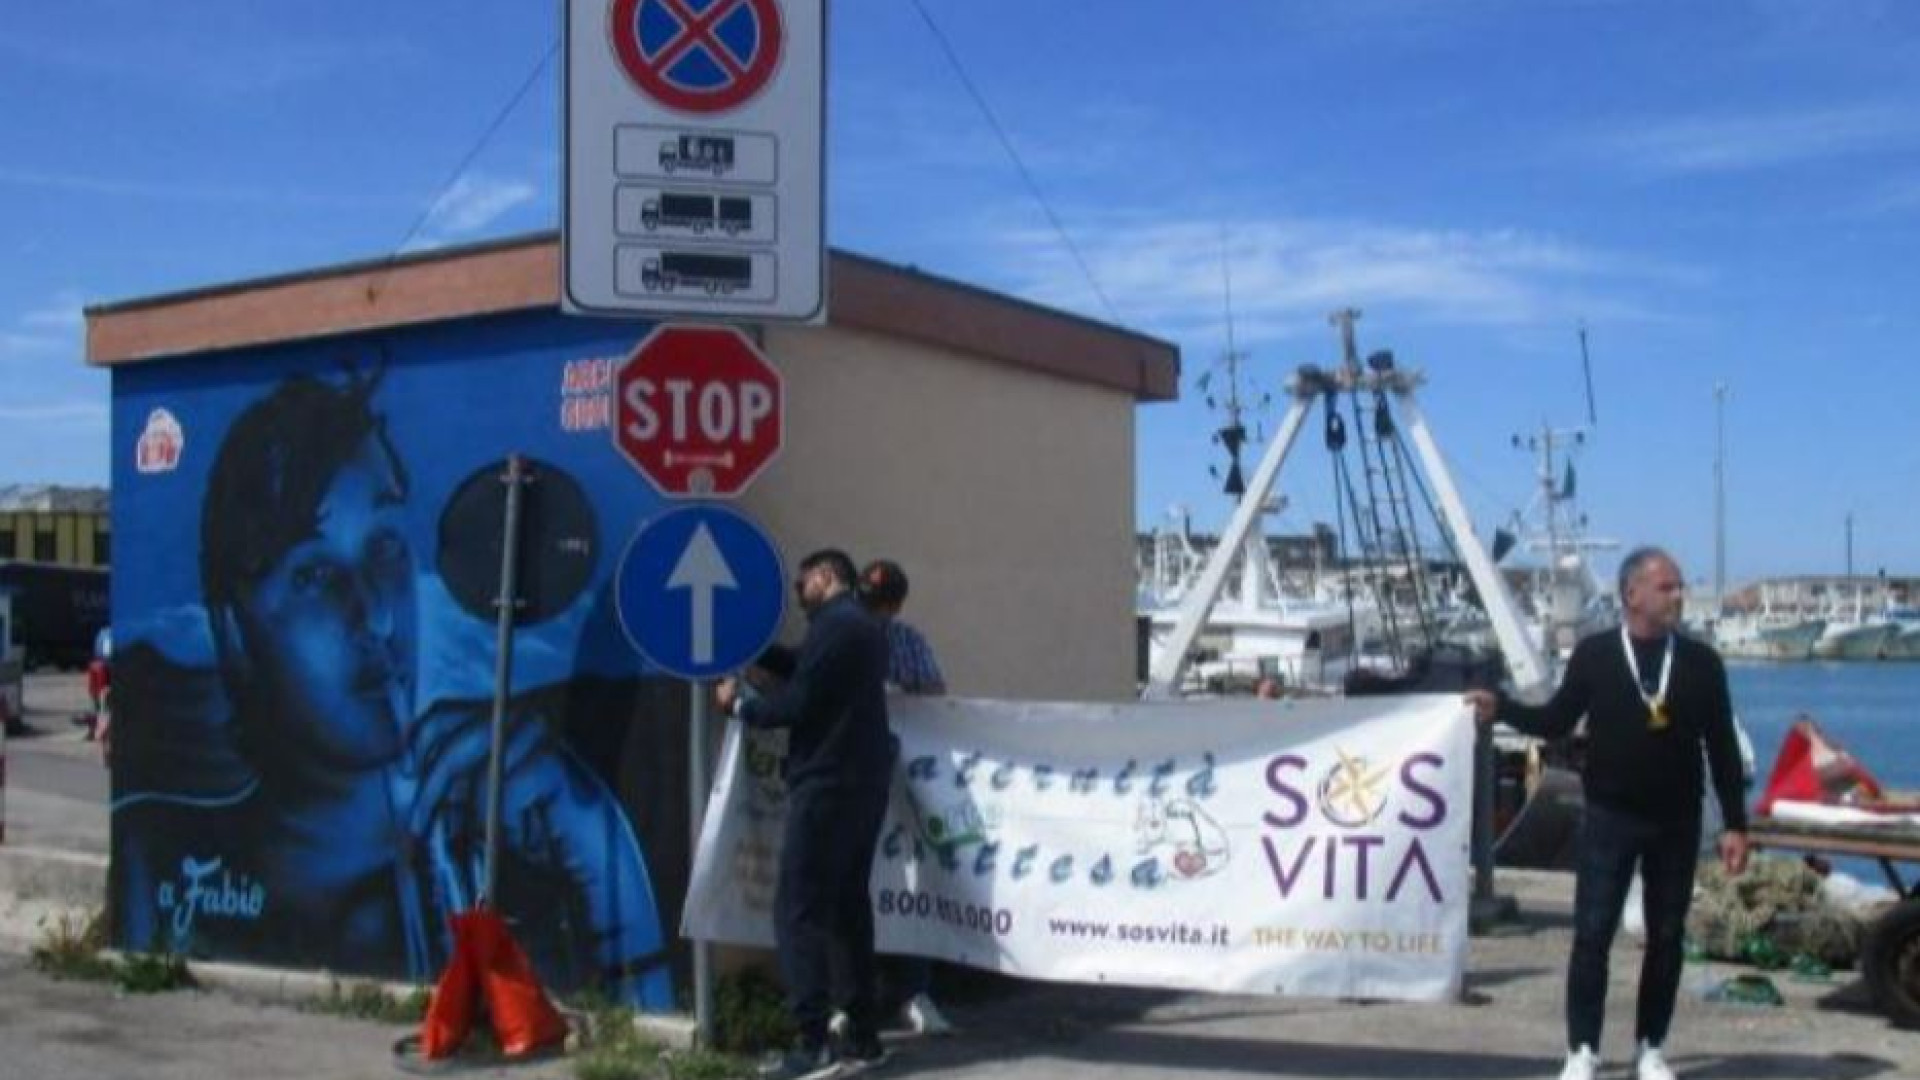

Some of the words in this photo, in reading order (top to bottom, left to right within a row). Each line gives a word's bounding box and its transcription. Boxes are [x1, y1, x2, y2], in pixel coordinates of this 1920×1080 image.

[625, 377, 775, 443] STOP
[905, 751, 1218, 797] aternità
[1261, 750, 1448, 830] SOS
[157, 882, 175, 909] a
[172, 854, 266, 938] Fabio
[1261, 836, 1444, 903] VITA
[1049, 917, 1231, 947] www.sosvita.it
[1253, 927, 1299, 950] THE
[1303, 929, 1355, 952] WAY
[1356, 931, 1392, 953] TO
[1398, 931, 1444, 954] LIFE
